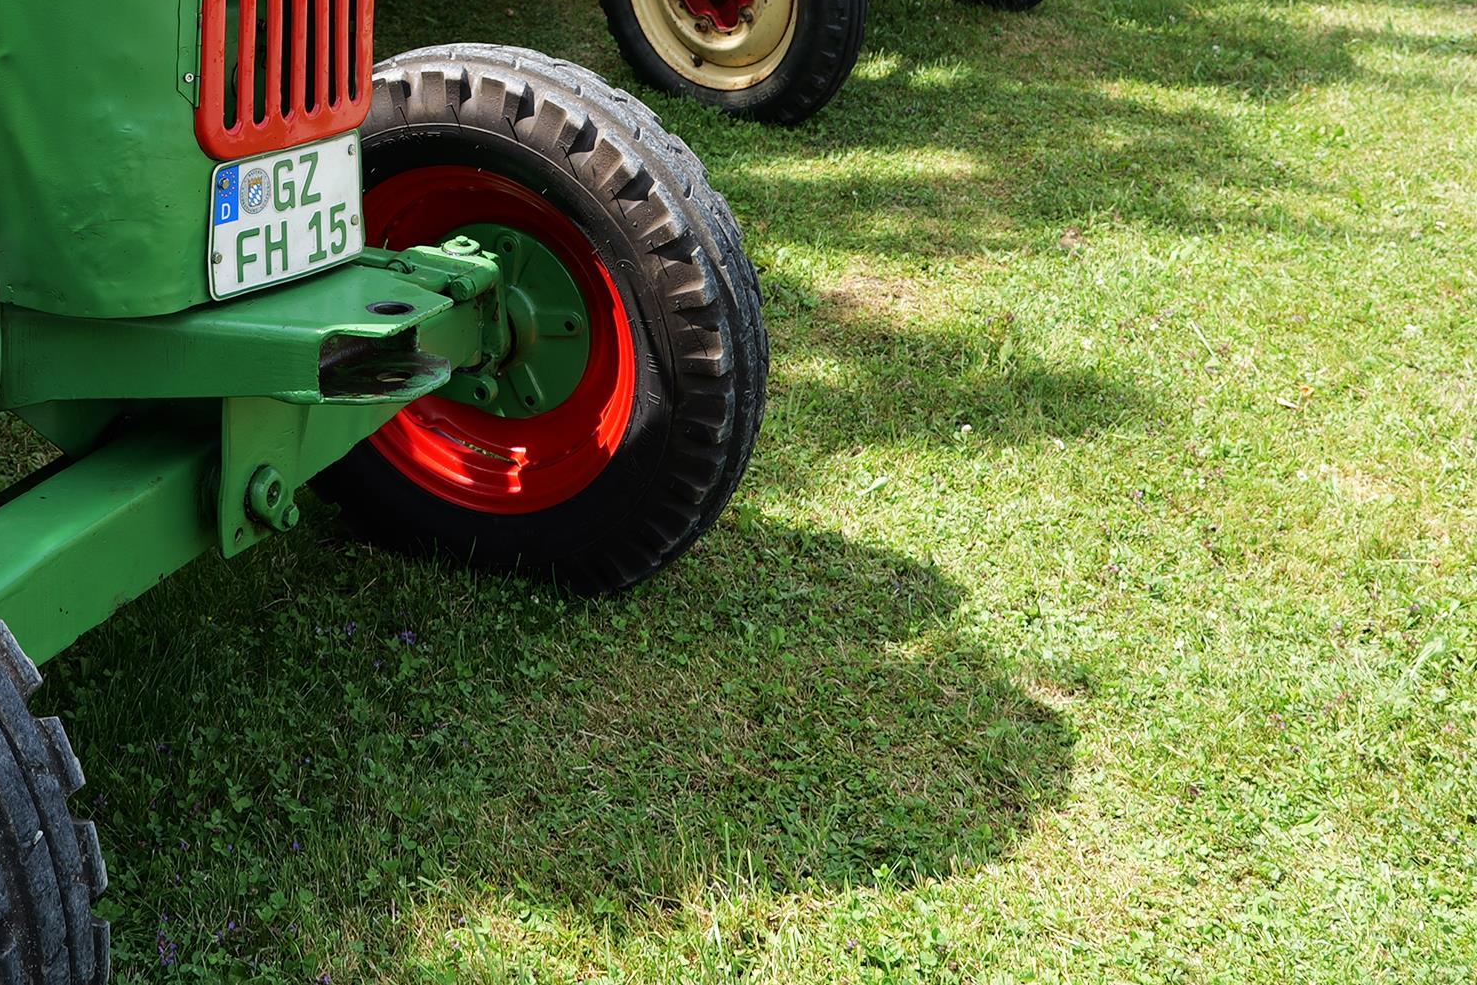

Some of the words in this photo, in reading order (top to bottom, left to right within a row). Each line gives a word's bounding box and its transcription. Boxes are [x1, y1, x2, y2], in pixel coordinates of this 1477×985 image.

[221, 203, 231, 220] D
[273, 151, 321, 212] GZ
[236, 220, 288, 283] FH
[308, 202, 347, 263] 15
